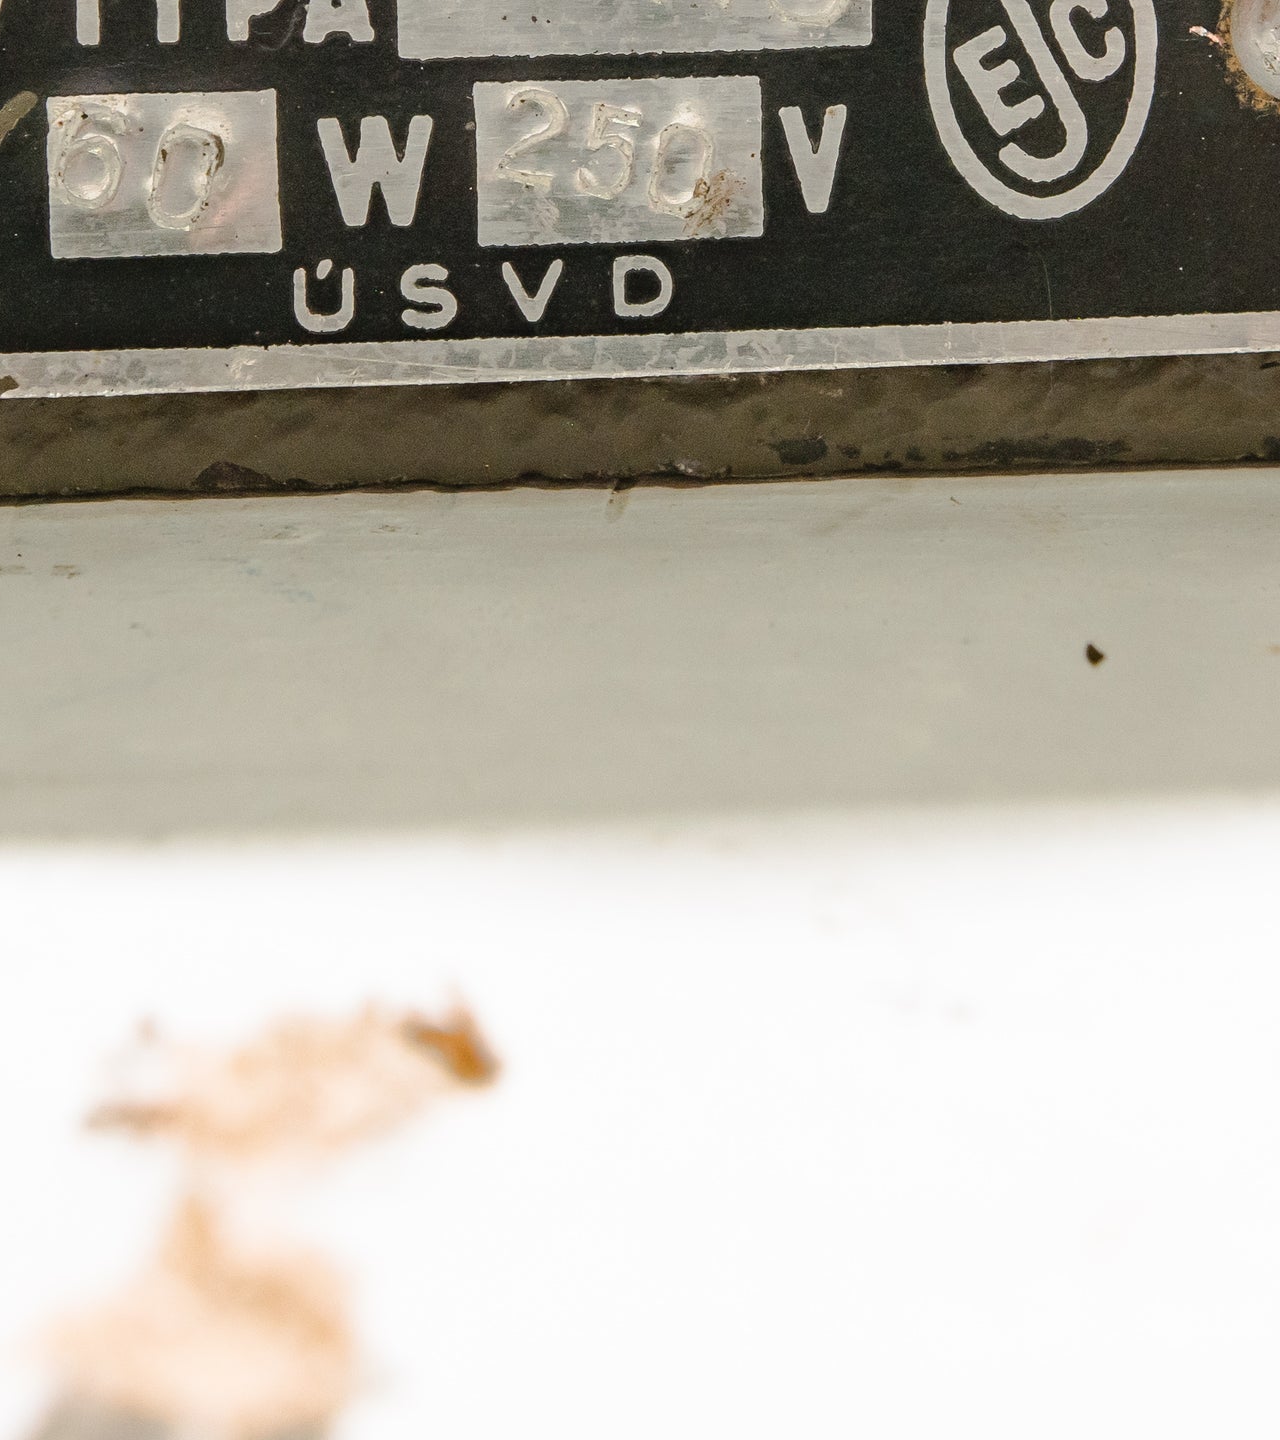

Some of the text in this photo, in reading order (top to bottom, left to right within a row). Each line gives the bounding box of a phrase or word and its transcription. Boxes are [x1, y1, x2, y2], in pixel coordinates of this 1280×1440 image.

[53, 86, 847, 232] 60 W 250 V
